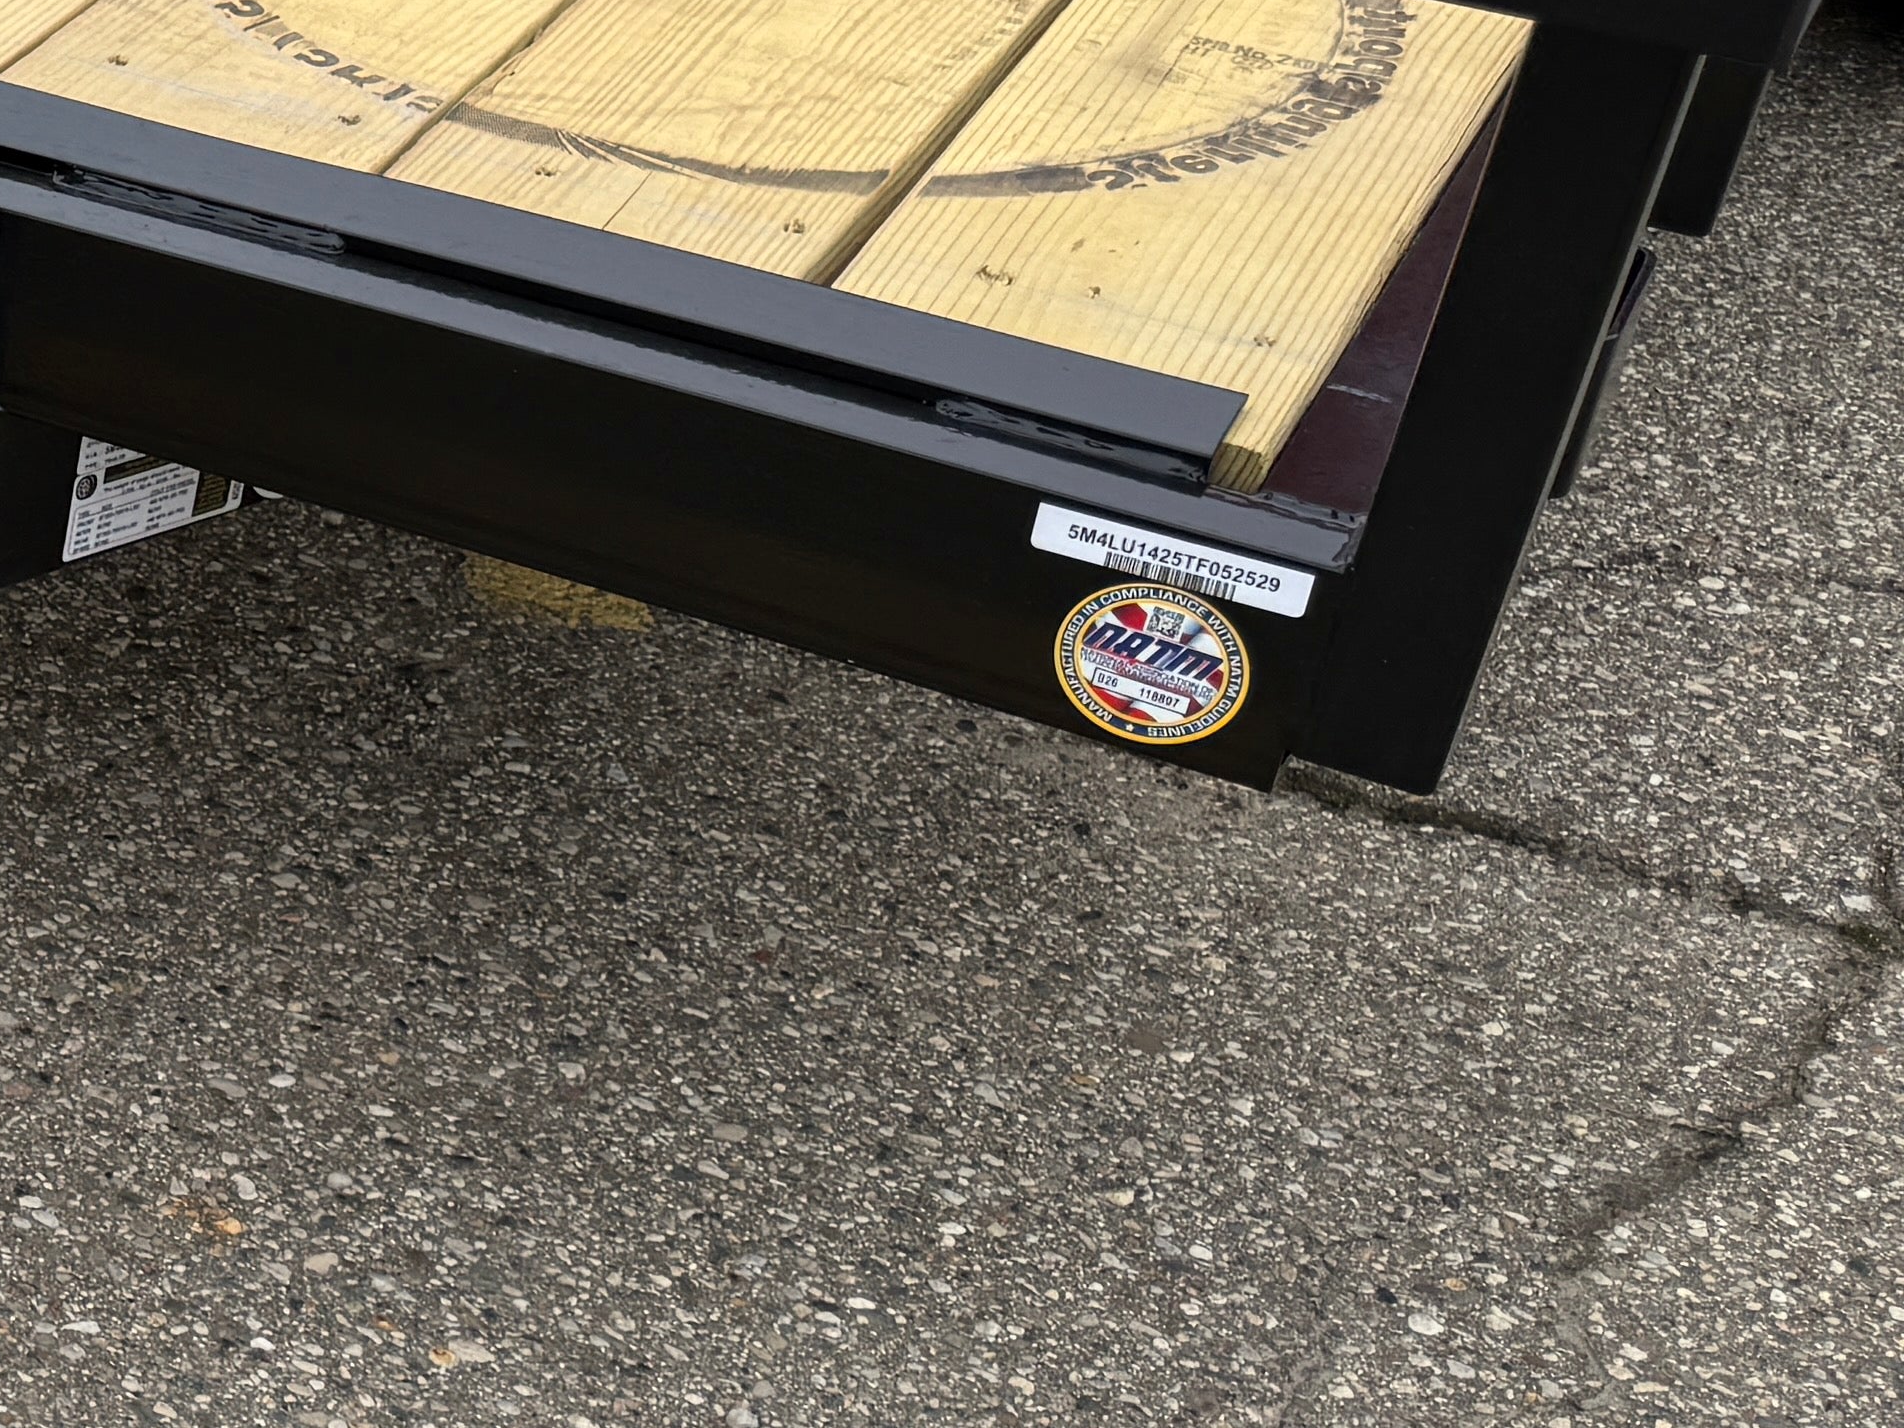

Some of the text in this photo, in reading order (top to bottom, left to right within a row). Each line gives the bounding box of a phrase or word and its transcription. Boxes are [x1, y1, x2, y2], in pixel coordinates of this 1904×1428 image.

[1068, 524, 1280, 592] 5M4LU1425TF052529
[1082, 603, 1099, 615] IN
[1100, 587, 1208, 617] COMPLIANCE
[1083, 622, 1224, 681] NATM
[1208, 615, 1233, 651] WITH
[1062, 614, 1113, 722] MANUFACTURED
[1229, 652, 1243, 701] NATM
[1147, 700, 1231, 737] GUIDELINES
